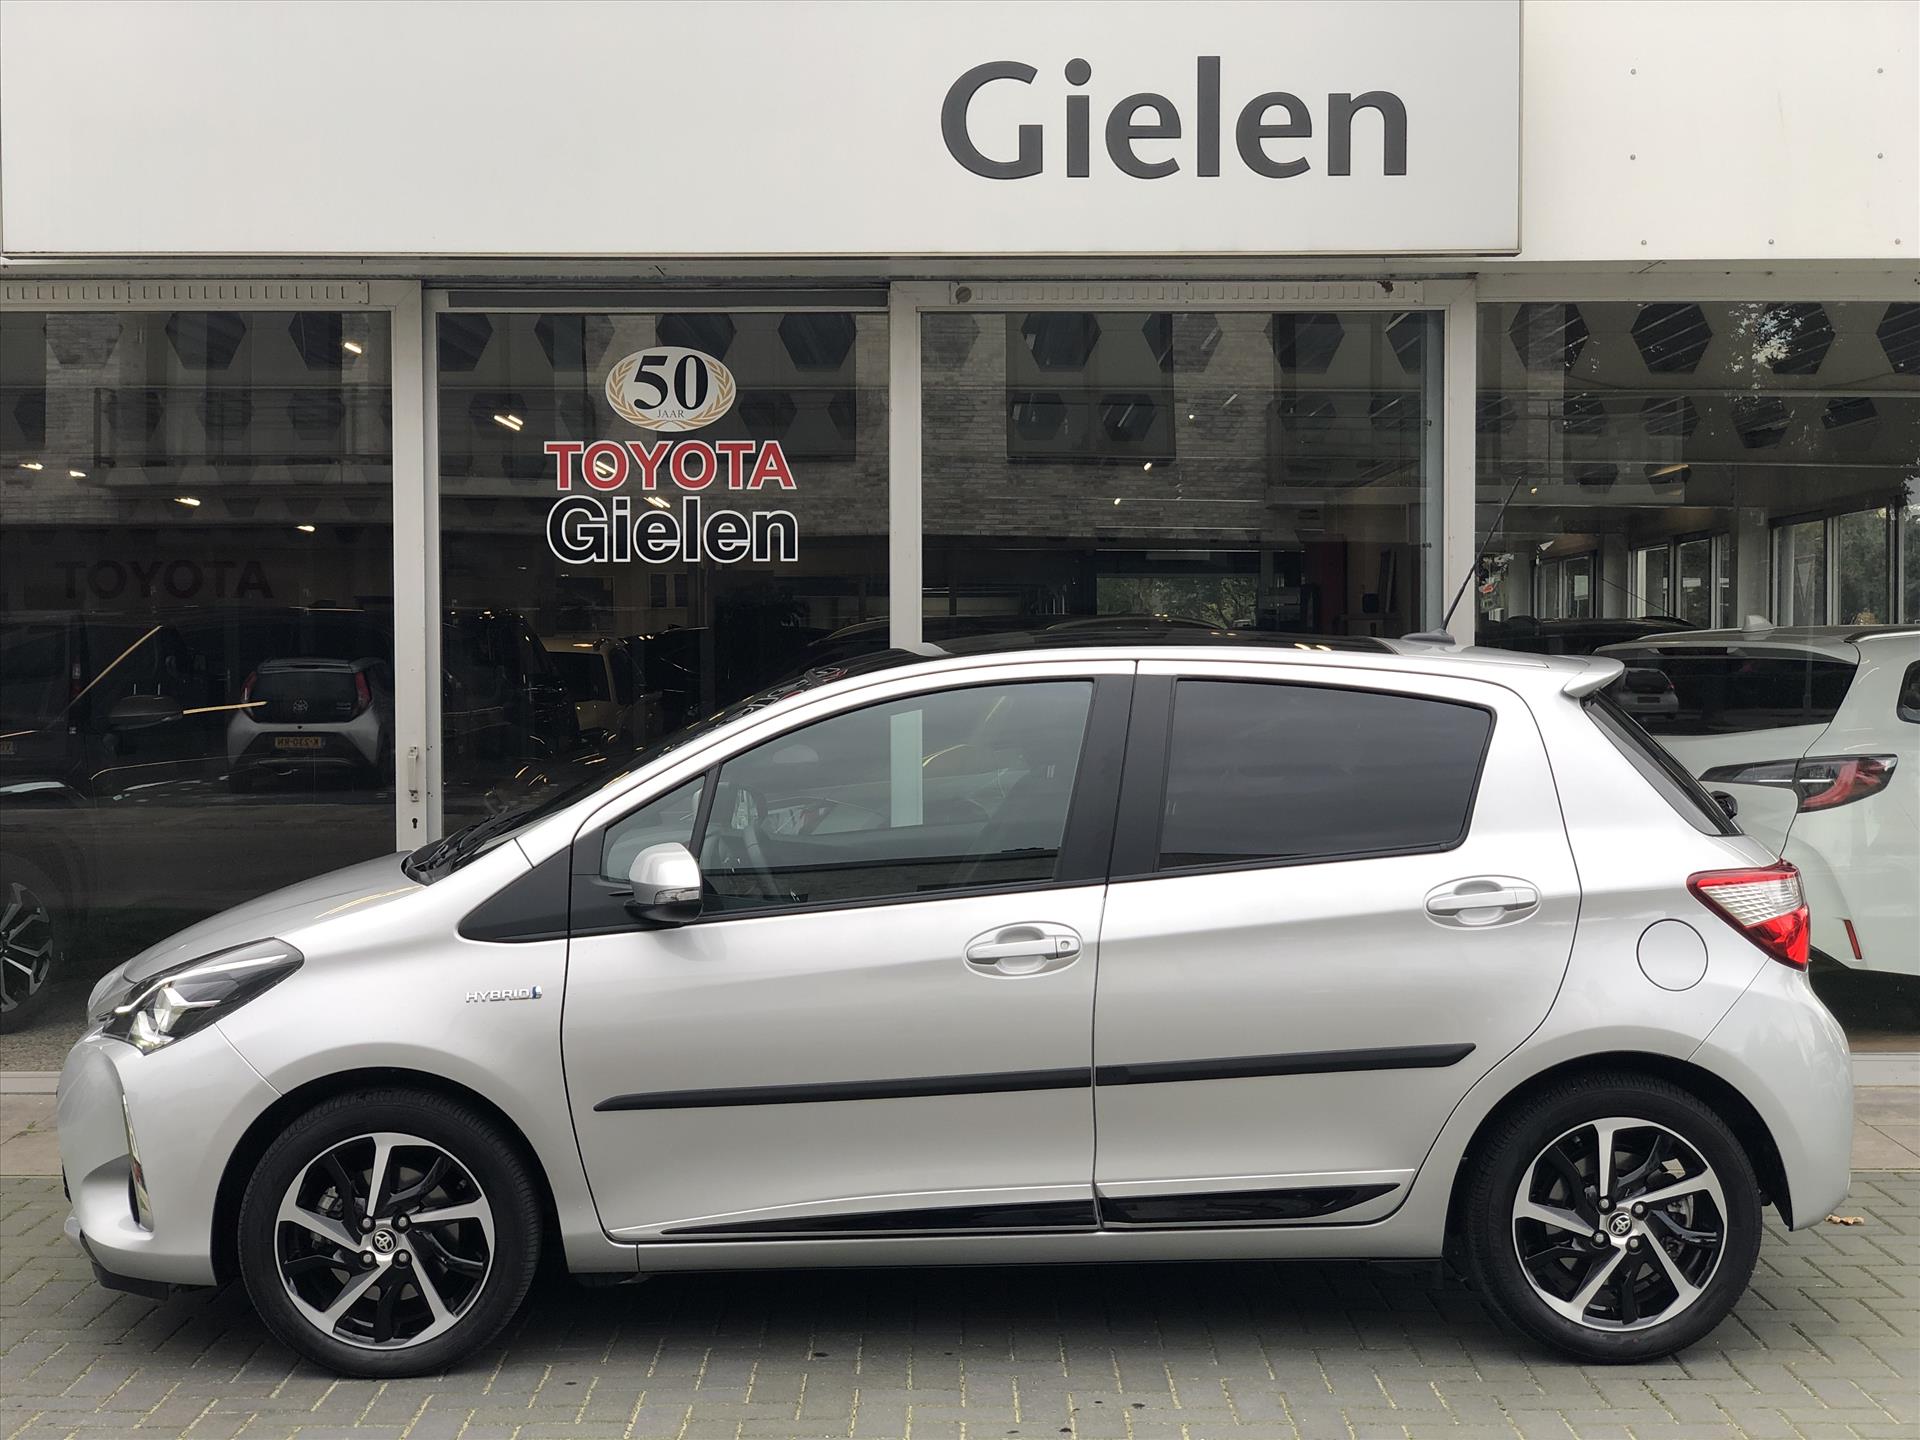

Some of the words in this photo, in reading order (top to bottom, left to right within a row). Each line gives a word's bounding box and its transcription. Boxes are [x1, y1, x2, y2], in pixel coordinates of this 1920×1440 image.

[941, 55, 1407, 179] Gielen
[633, 354, 709, 410] 50
[657, 409, 685, 419] JAAR
[544, 440, 797, 491] TOYOTA
[546, 495, 799, 564] Gielen
[55, 559, 274, 600] TOYOTA
[465, 989, 530, 1003] HYBRID
